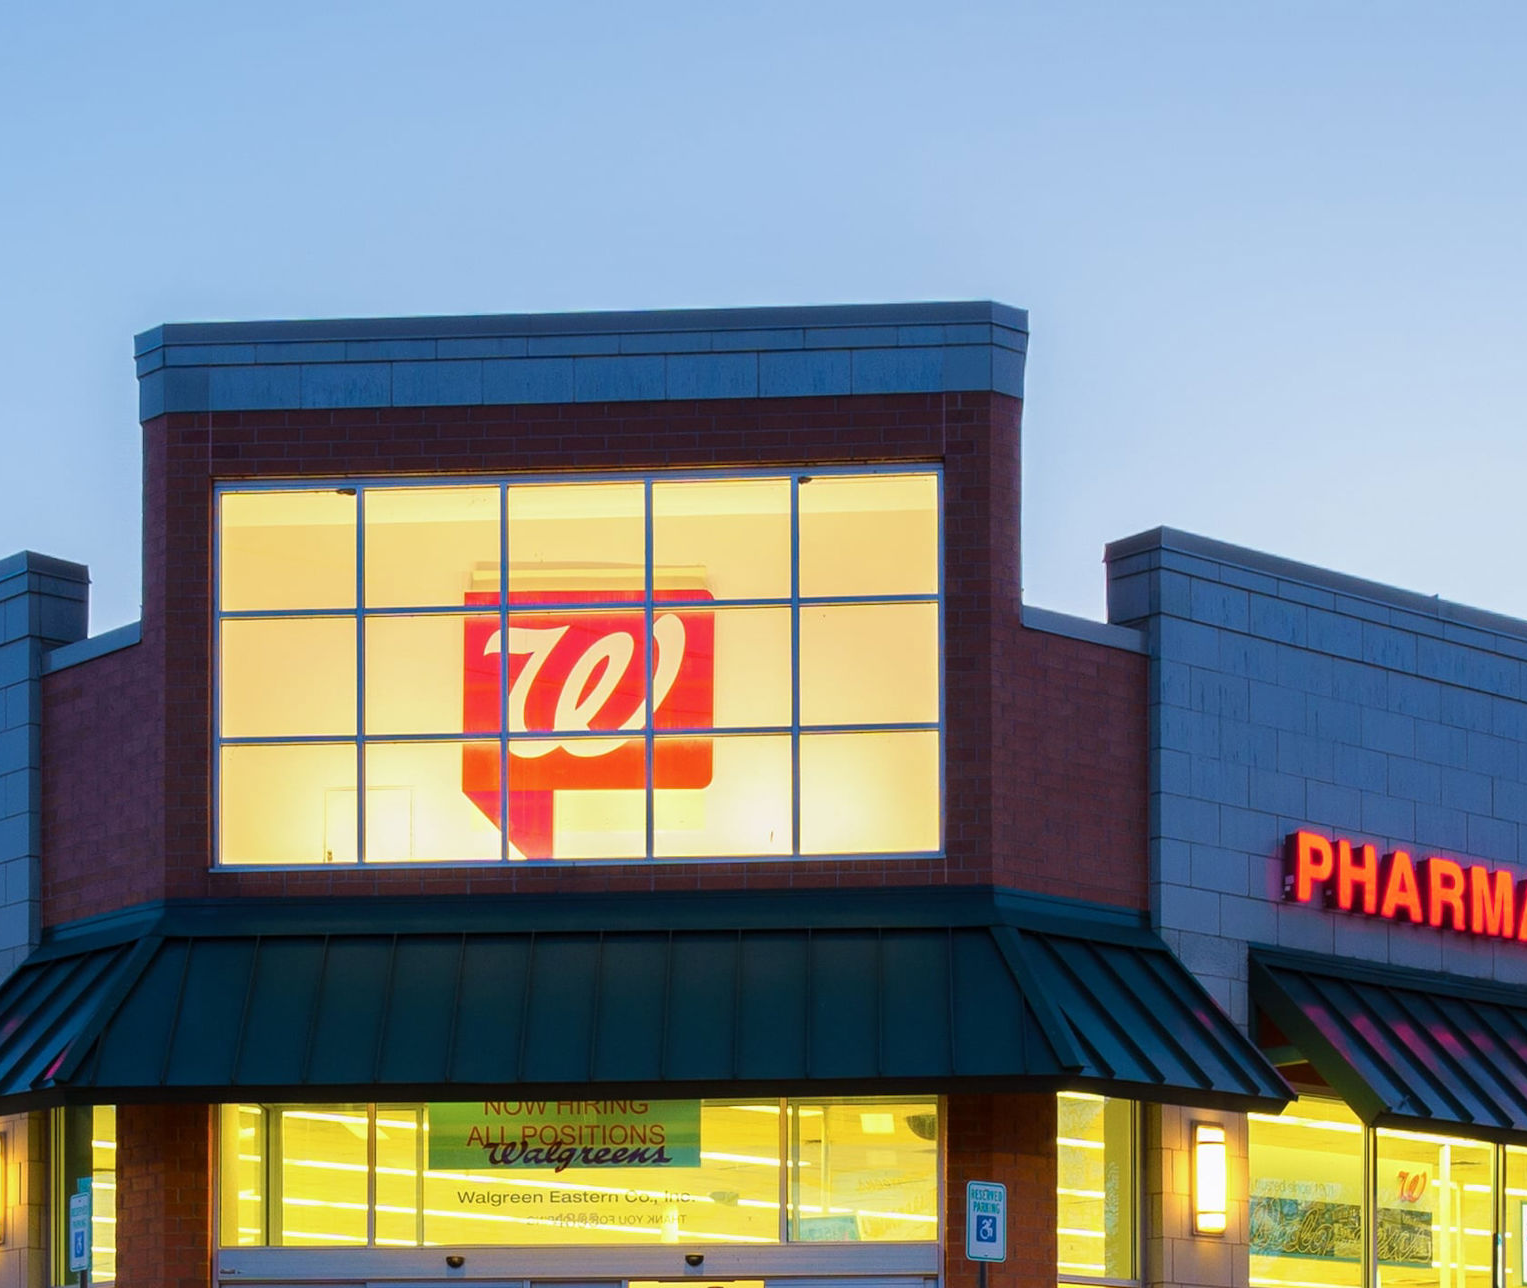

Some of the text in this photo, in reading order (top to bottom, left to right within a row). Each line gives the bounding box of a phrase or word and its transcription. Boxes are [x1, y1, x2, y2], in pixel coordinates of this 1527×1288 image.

[484, 1100, 649, 1116] NOW HIRING
[466, 1123, 666, 1147] ALL POSITIONS
[483, 1139, 674, 1173] Walgreens
[457, 1190, 544, 1207] Walgreen
[549, 1190, 620, 1204] Eastern
[971, 1188, 1003, 1202] RESERVED
[973, 1200, 1001, 1214] PARKING
